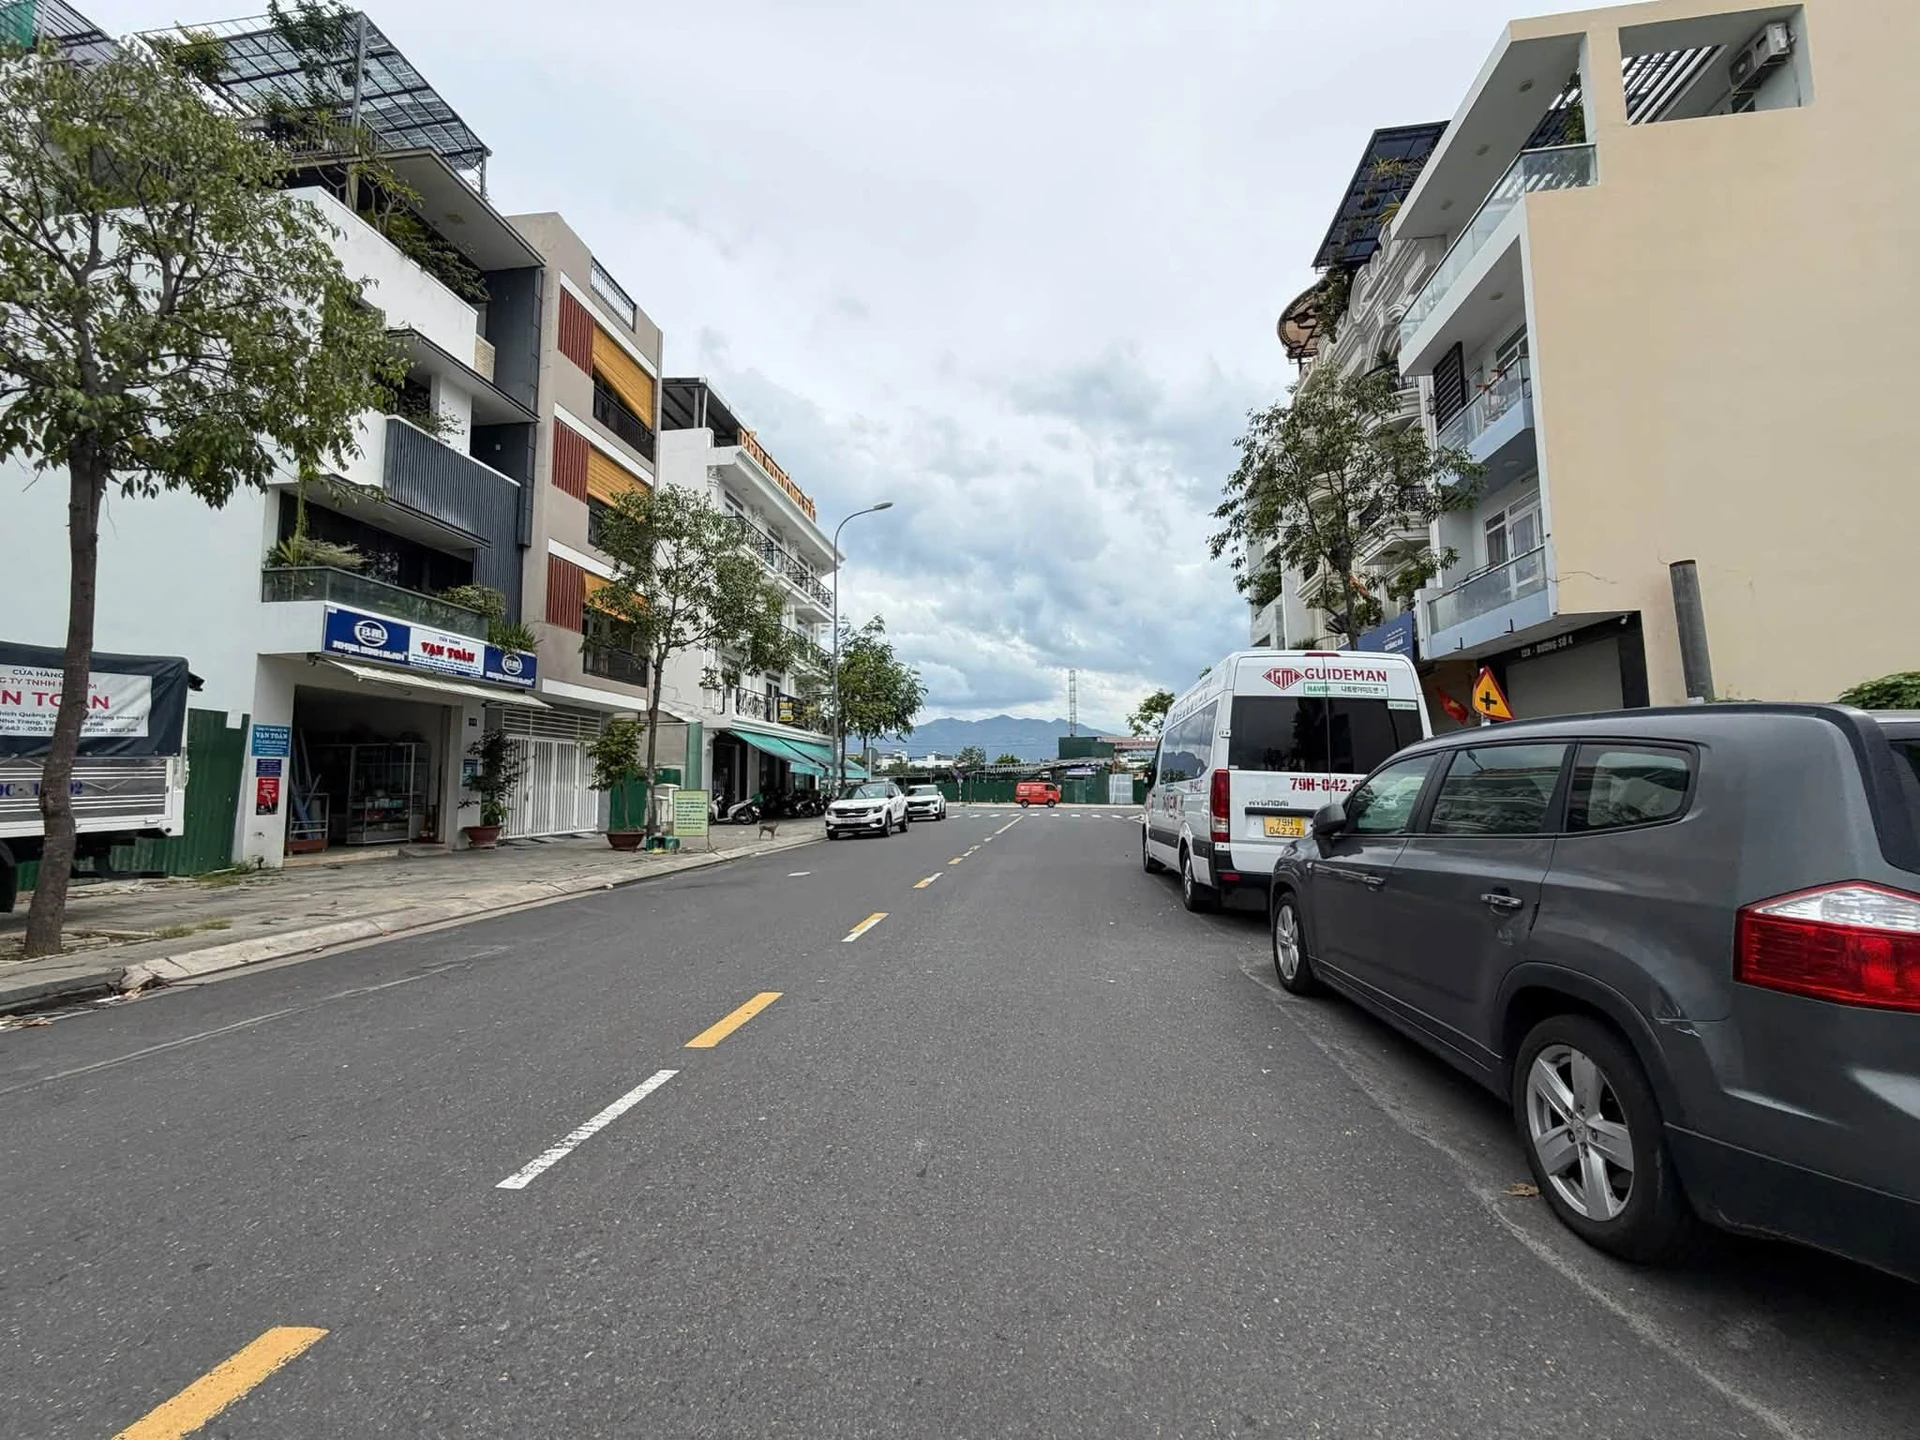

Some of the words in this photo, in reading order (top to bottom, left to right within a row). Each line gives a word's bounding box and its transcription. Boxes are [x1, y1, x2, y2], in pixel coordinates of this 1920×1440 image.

[421, 641, 445, 656] VẠN
[446, 647, 475, 662] TOÀN
[1304, 668, 1387, 682] GUIDEMAN
[25, 679, 56, 687] TNHH
[1306, 684, 1331, 693] NAVER
[1275, 818, 1294, 827] 79H
